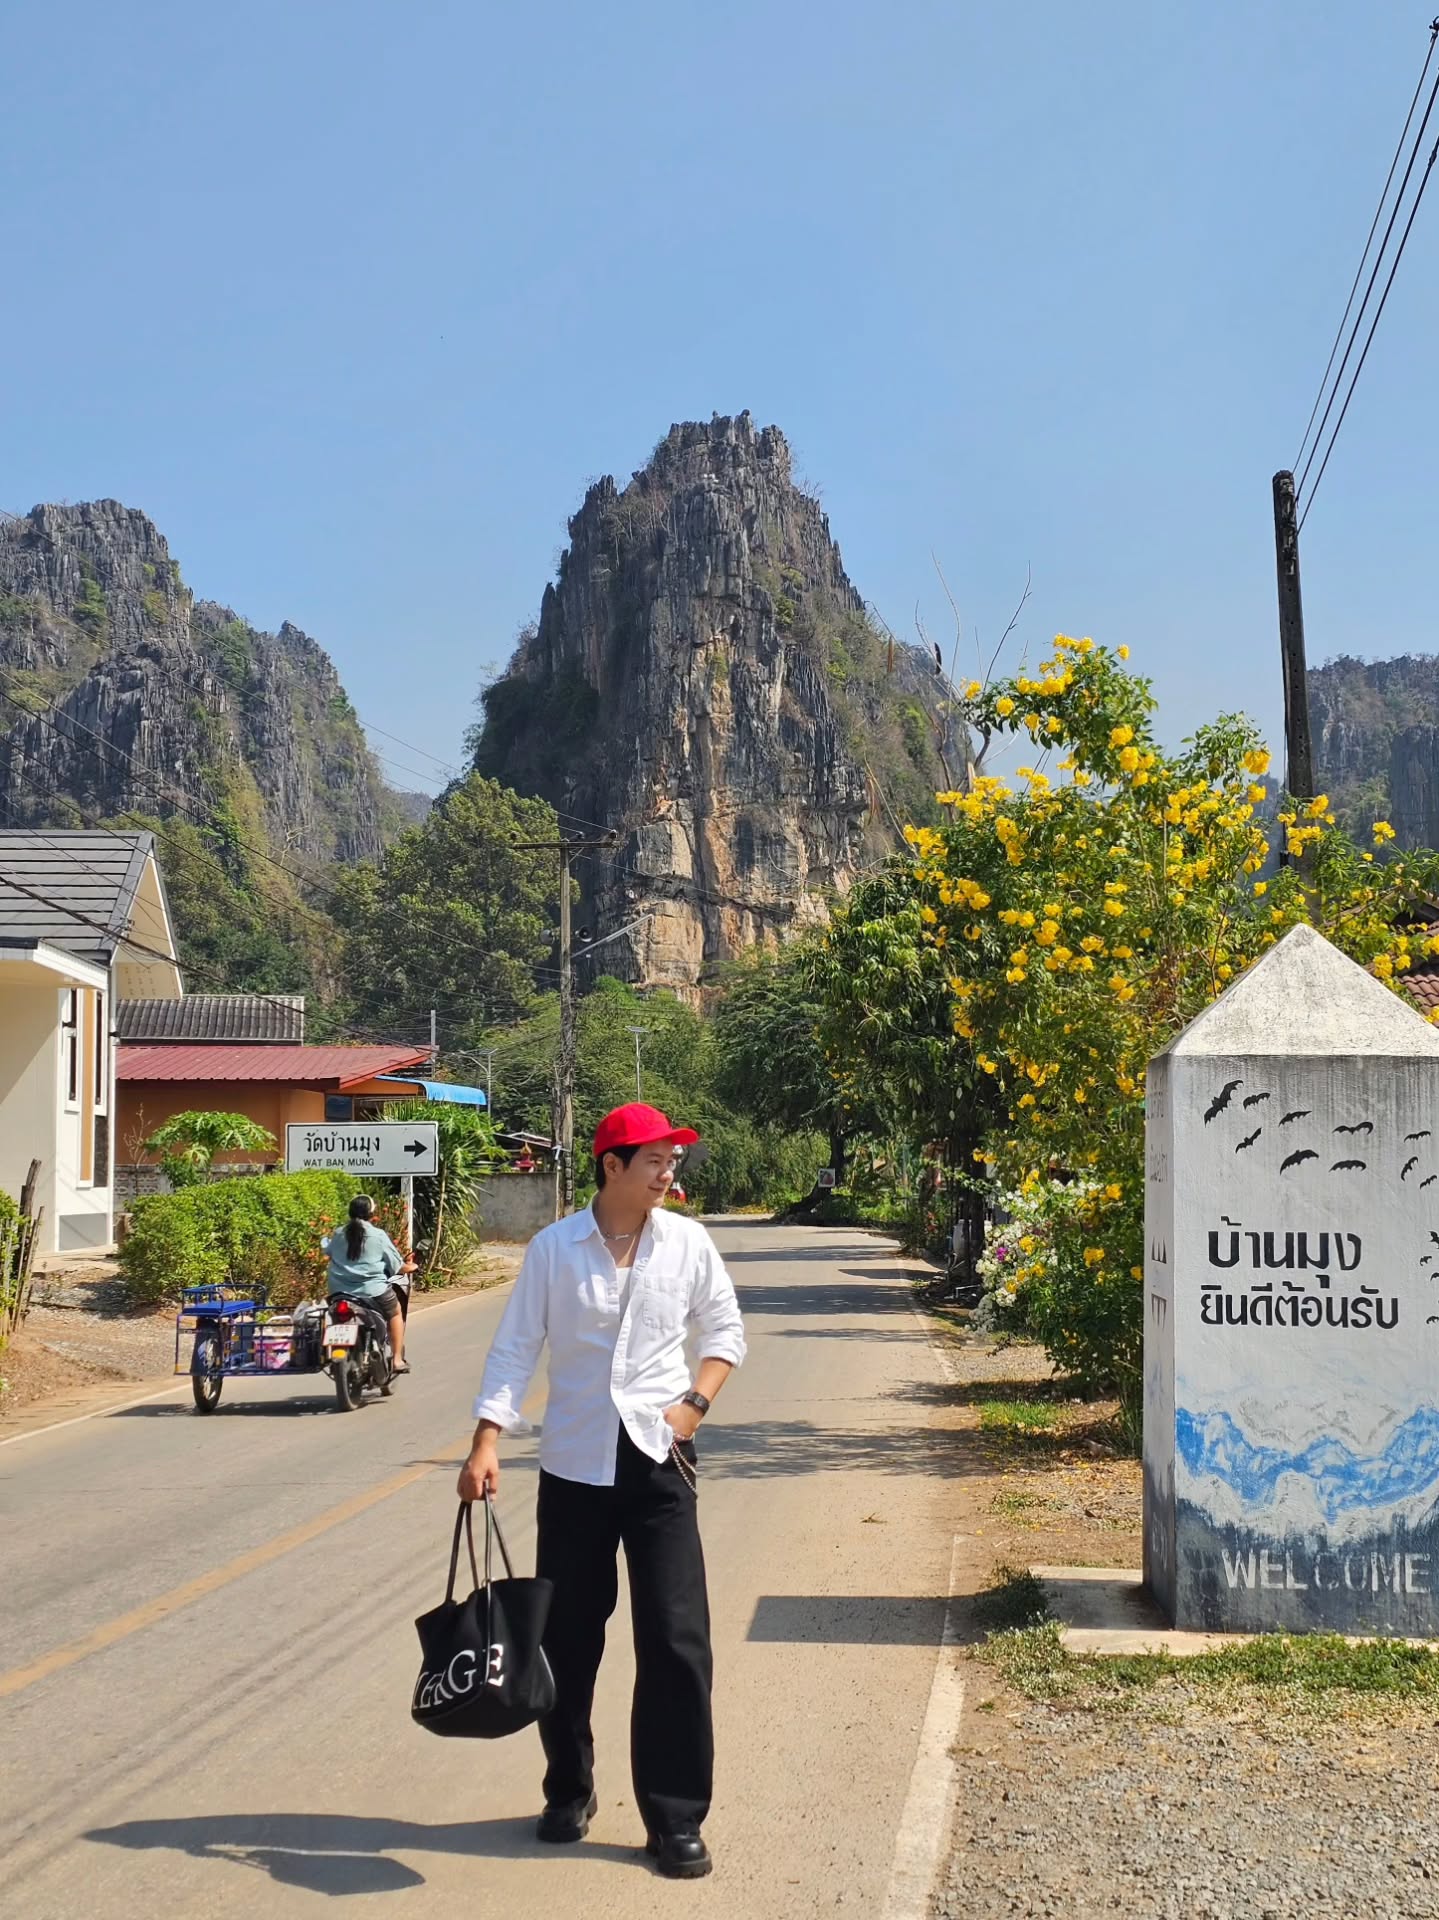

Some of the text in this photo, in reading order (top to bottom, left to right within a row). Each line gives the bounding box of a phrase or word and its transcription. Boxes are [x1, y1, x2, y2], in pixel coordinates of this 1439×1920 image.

[303, 1131, 381, 1158] วัดบ้านมุง
[303, 1158, 375, 1167] WAT BAN MUNG
[1207, 1215, 1362, 1289] บ้านมุง
[1200, 1280, 1399, 1329] ยินดีต้อนรับ
[1221, 1548, 1432, 1594] WELCOME
